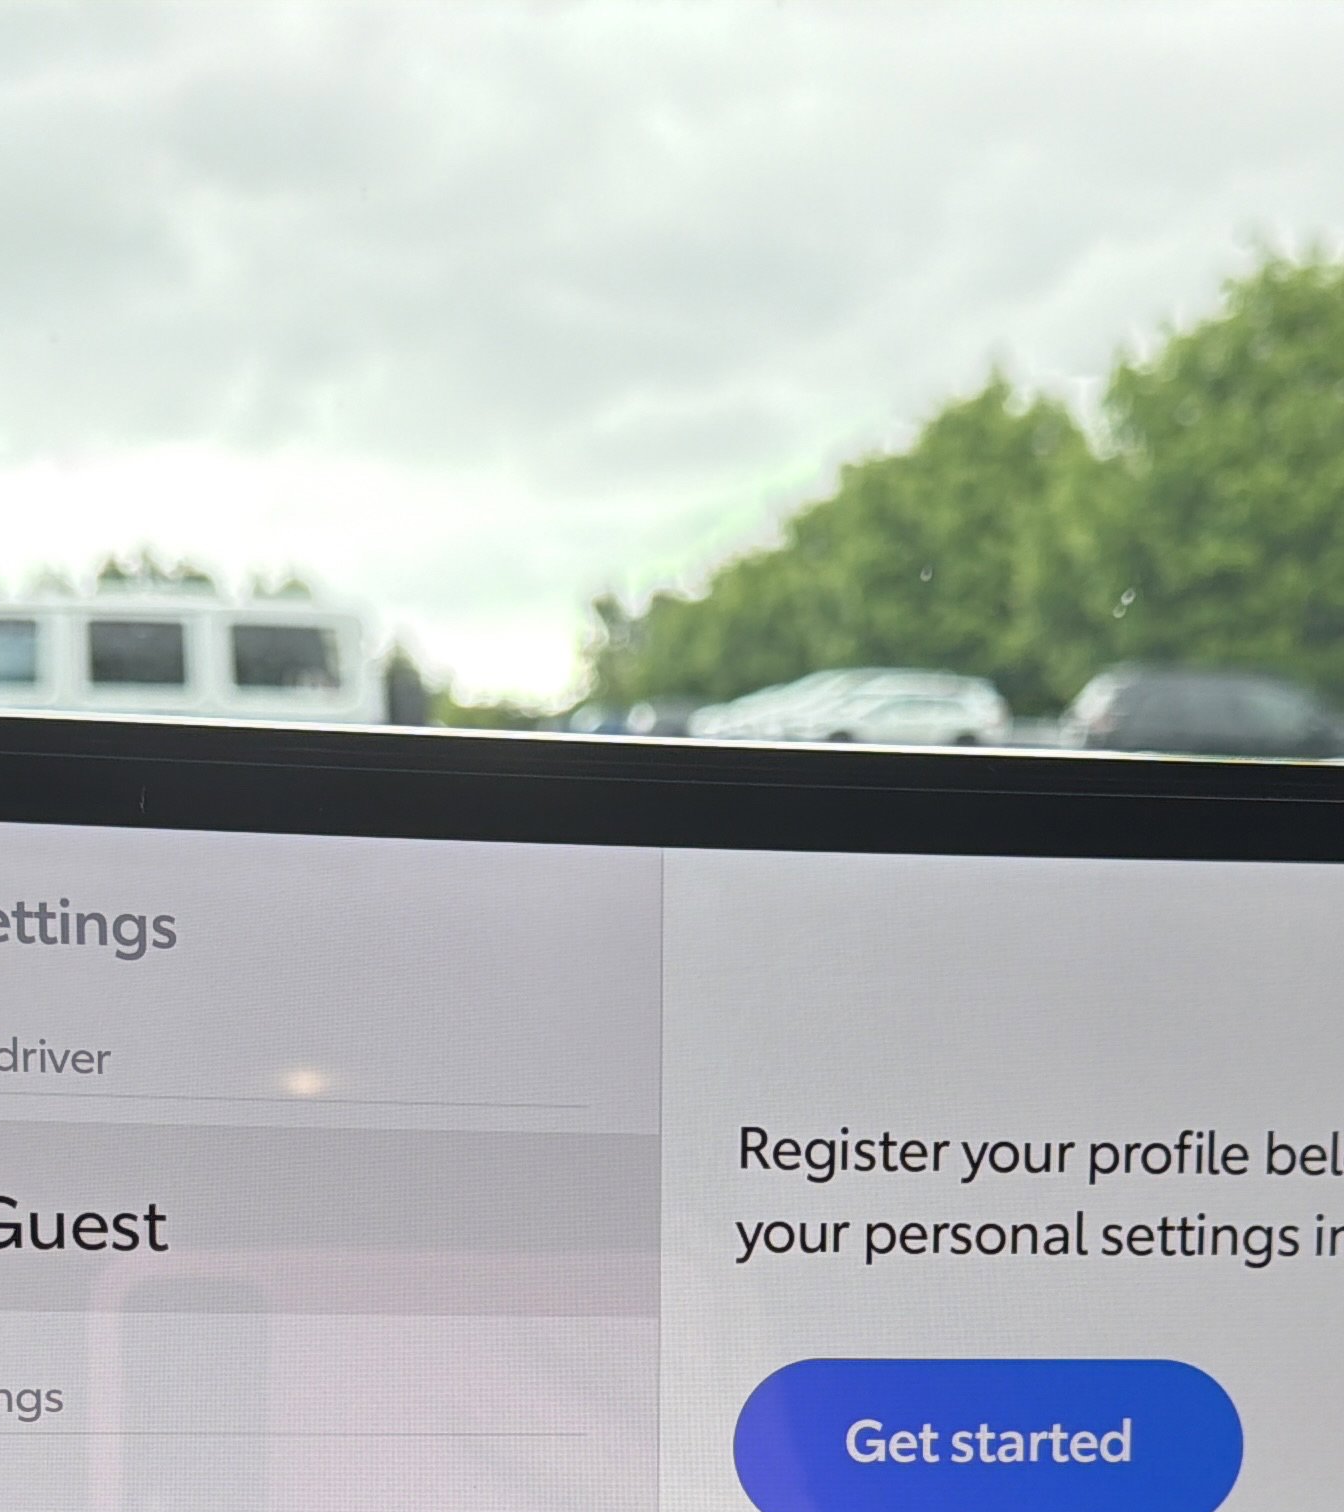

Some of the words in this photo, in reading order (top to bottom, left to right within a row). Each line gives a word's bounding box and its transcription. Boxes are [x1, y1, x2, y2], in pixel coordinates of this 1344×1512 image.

[739, 1126, 950, 1184] Register
[960, 1140, 1076, 1184] your
[1089, 1128, 1250, 1186] profile
[735, 1220, 851, 1264] your
[866, 1210, 1089, 1266] personal
[1101, 1213, 1300, 1269] settings
[844, 1419, 938, 1465] Get
[948, 1416, 1134, 1465] started
